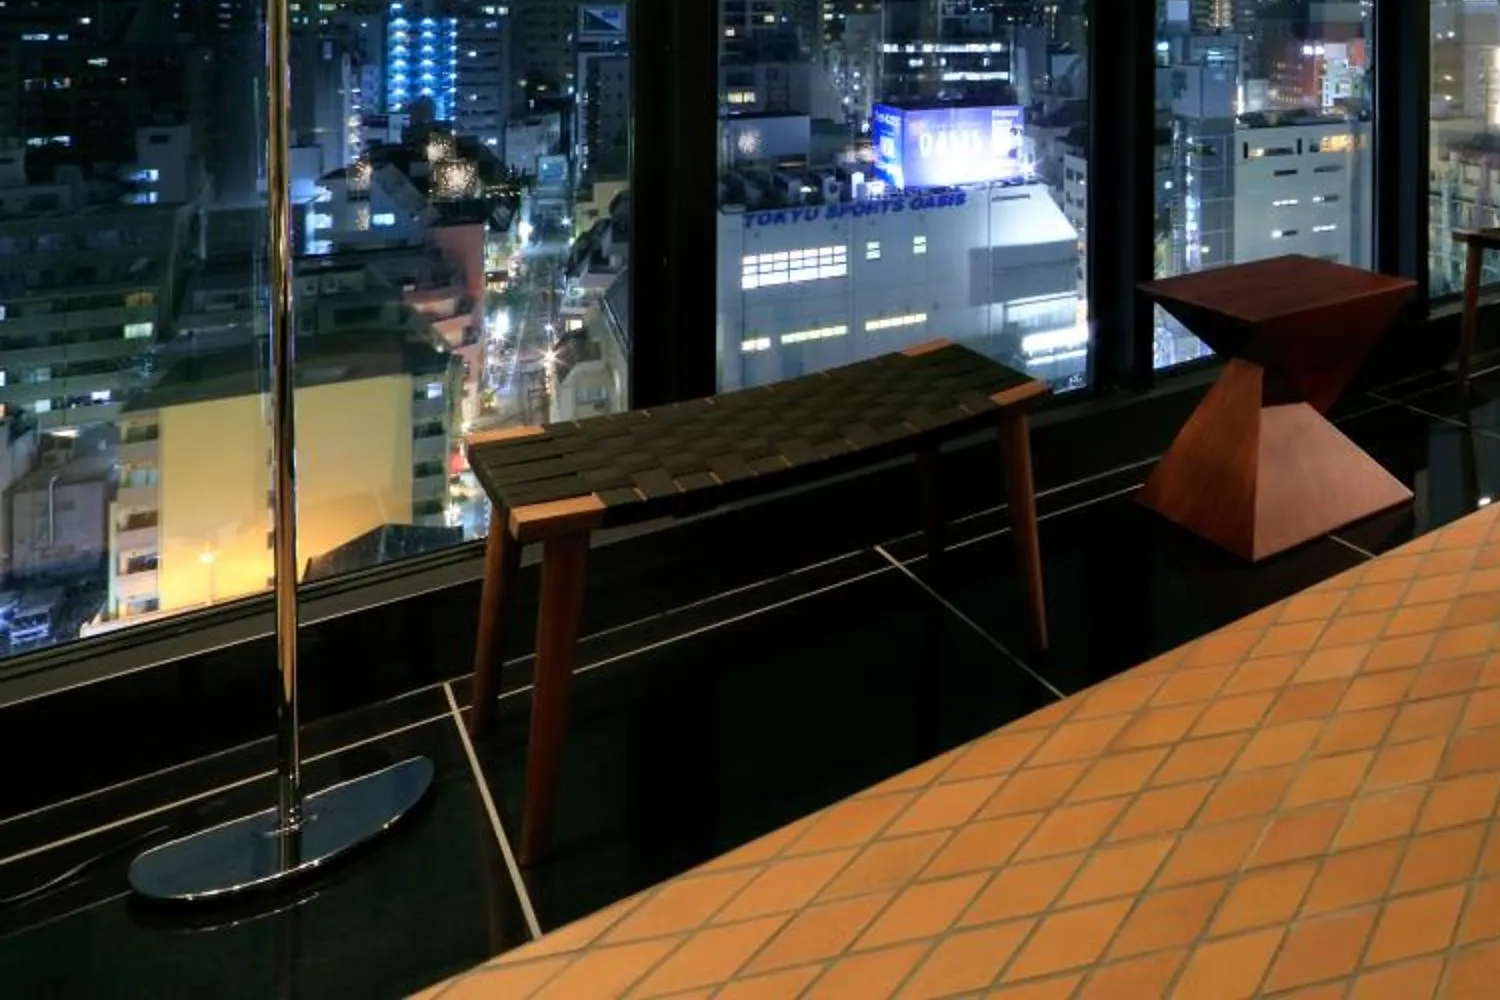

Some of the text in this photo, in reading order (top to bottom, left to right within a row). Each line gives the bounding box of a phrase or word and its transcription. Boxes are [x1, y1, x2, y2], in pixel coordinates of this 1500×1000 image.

[742, 192, 967, 228] TOKYU SPORTS OASIS
